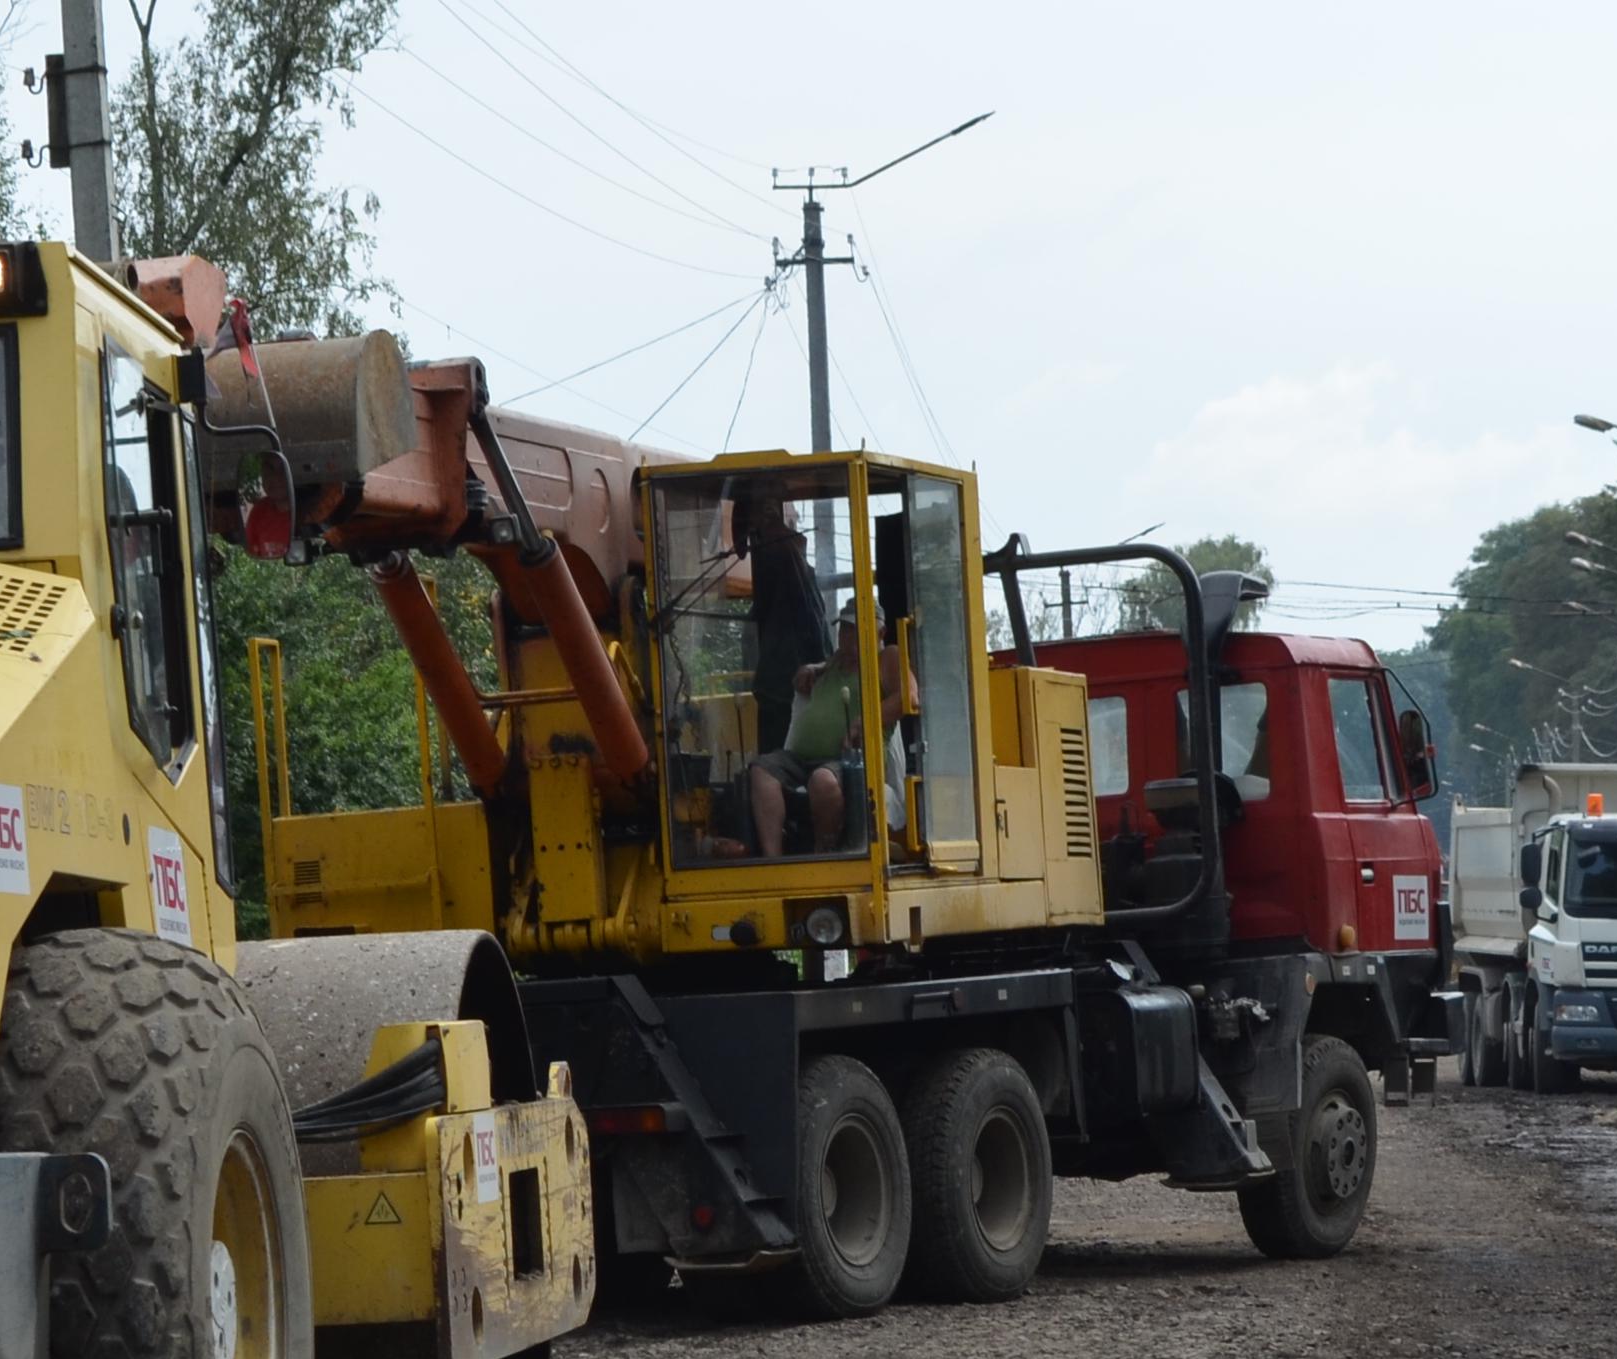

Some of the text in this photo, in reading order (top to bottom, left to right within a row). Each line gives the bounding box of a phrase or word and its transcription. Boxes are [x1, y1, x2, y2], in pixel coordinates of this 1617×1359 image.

[153, 854, 185, 912] ПБС
[1397, 889, 1425, 914] ПБС
[476, 1131, 495, 1168] ПБС
